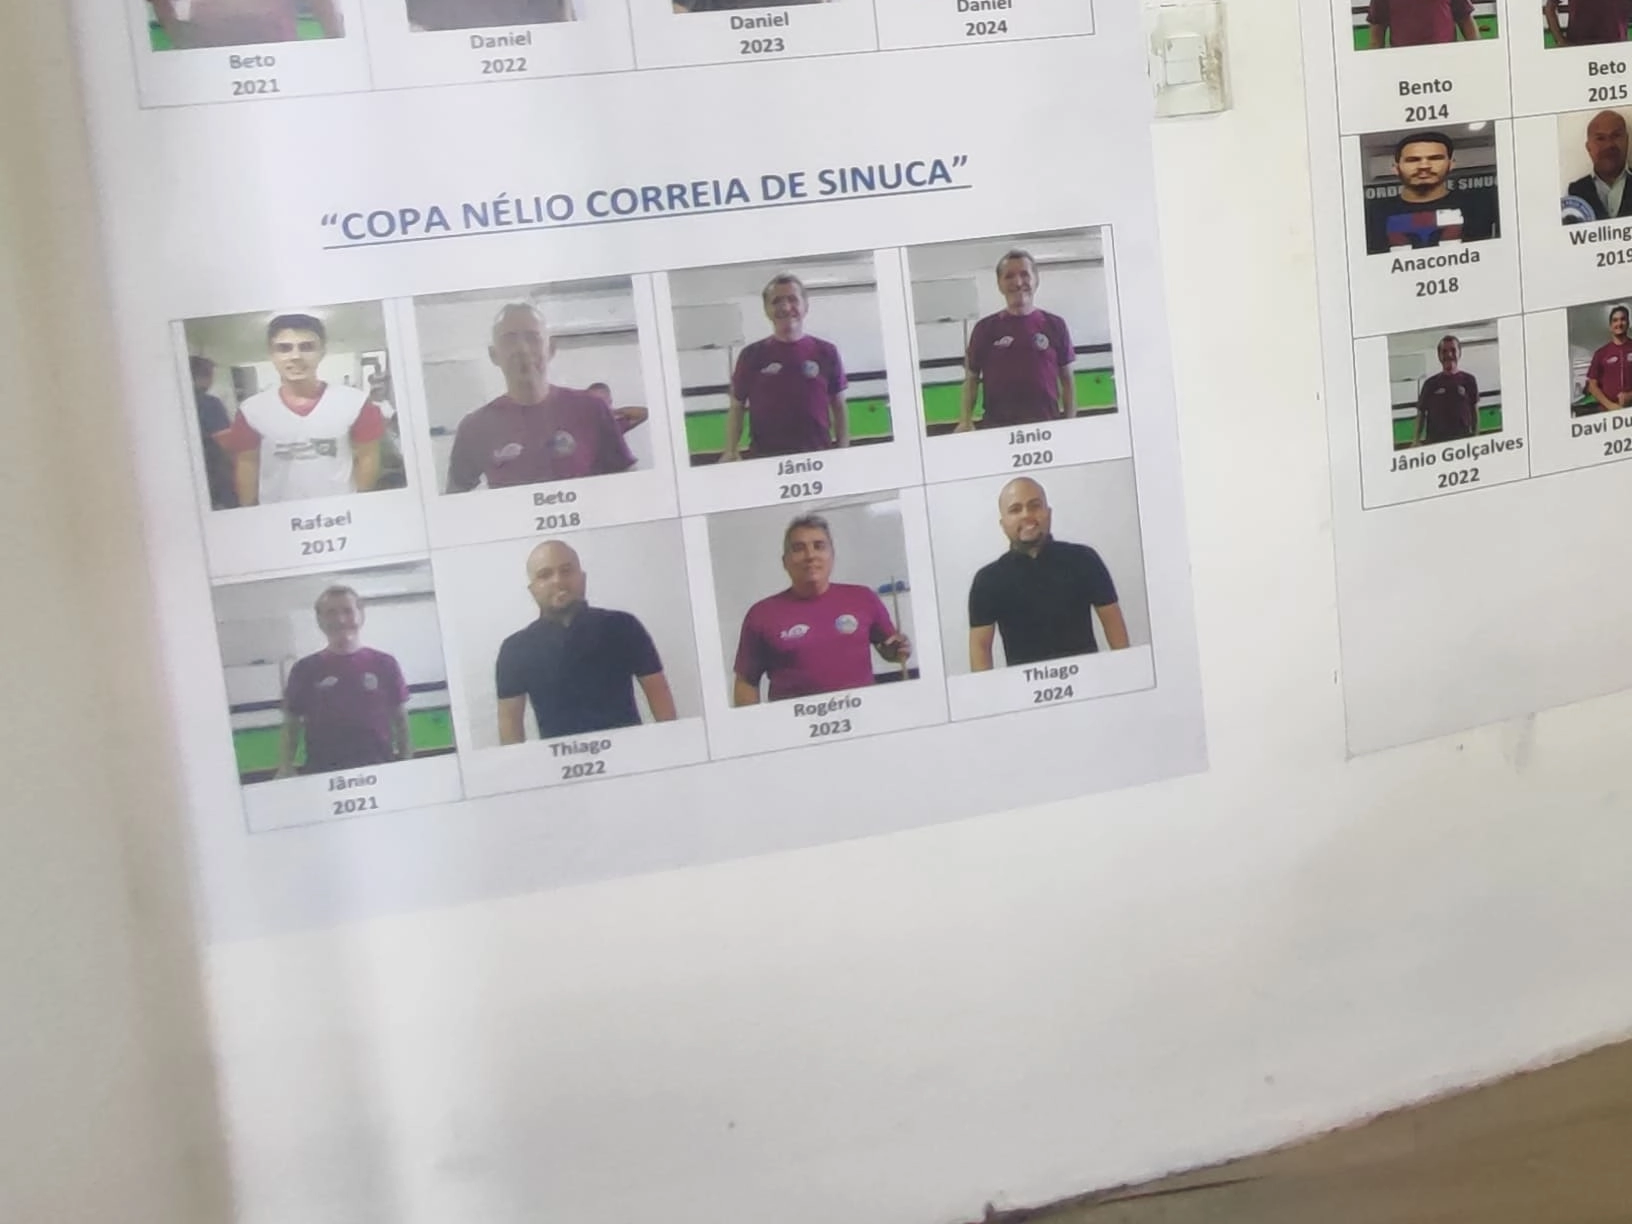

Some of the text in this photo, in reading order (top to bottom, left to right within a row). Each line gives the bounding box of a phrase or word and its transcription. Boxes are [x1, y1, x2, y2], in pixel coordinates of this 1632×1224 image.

[730, 12, 790, 30] Daniel
[965, 20, 1008, 36] 2024
[470, 30, 532, 50] Daniel
[739, 38, 785, 55] 2023
[229, 53, 275, 69] Beto
[480, 57, 527, 74] 2022
[1587, 59, 1627, 76] Beto
[232, 78, 281, 96] 2021
[1398, 77, 1453, 96] Bento
[1587, 84, 1628, 103] 2015
[1404, 103, 1449, 123] 2014
[463, 191, 575, 229] NÉLIO
[586, 177, 751, 219] CORREIA
[760, 173, 807, 202] DE
[1391, 250, 1481, 274] Anaconda
[1415, 277, 1460, 297] 2018
[1007, 427, 1052, 446] Jânio
[1571, 419, 1608, 439] Davi
[1011, 449, 1054, 468] 2020
[1390, 436, 1524, 473] Jânio Golçalves
[777, 457, 824, 476] Jânio
[1437, 468, 1480, 489] 2022
[533, 489, 577, 506] Beto
[780, 480, 823, 499] 2019
[291, 511, 352, 532] Rafael
[535, 512, 581, 531] 2018
[301, 537, 348, 555] 2017
[1022, 661, 1079, 683] Thiago
[1033, 685, 1074, 703] 2024
[793, 693, 862, 719] Rogério
[808, 718, 852, 738] 2023
[548, 736, 612, 759] Thiago
[561, 760, 607, 780] 2022
[327, 772, 377, 792] Jânio
[332, 796, 379, 815] 2021
